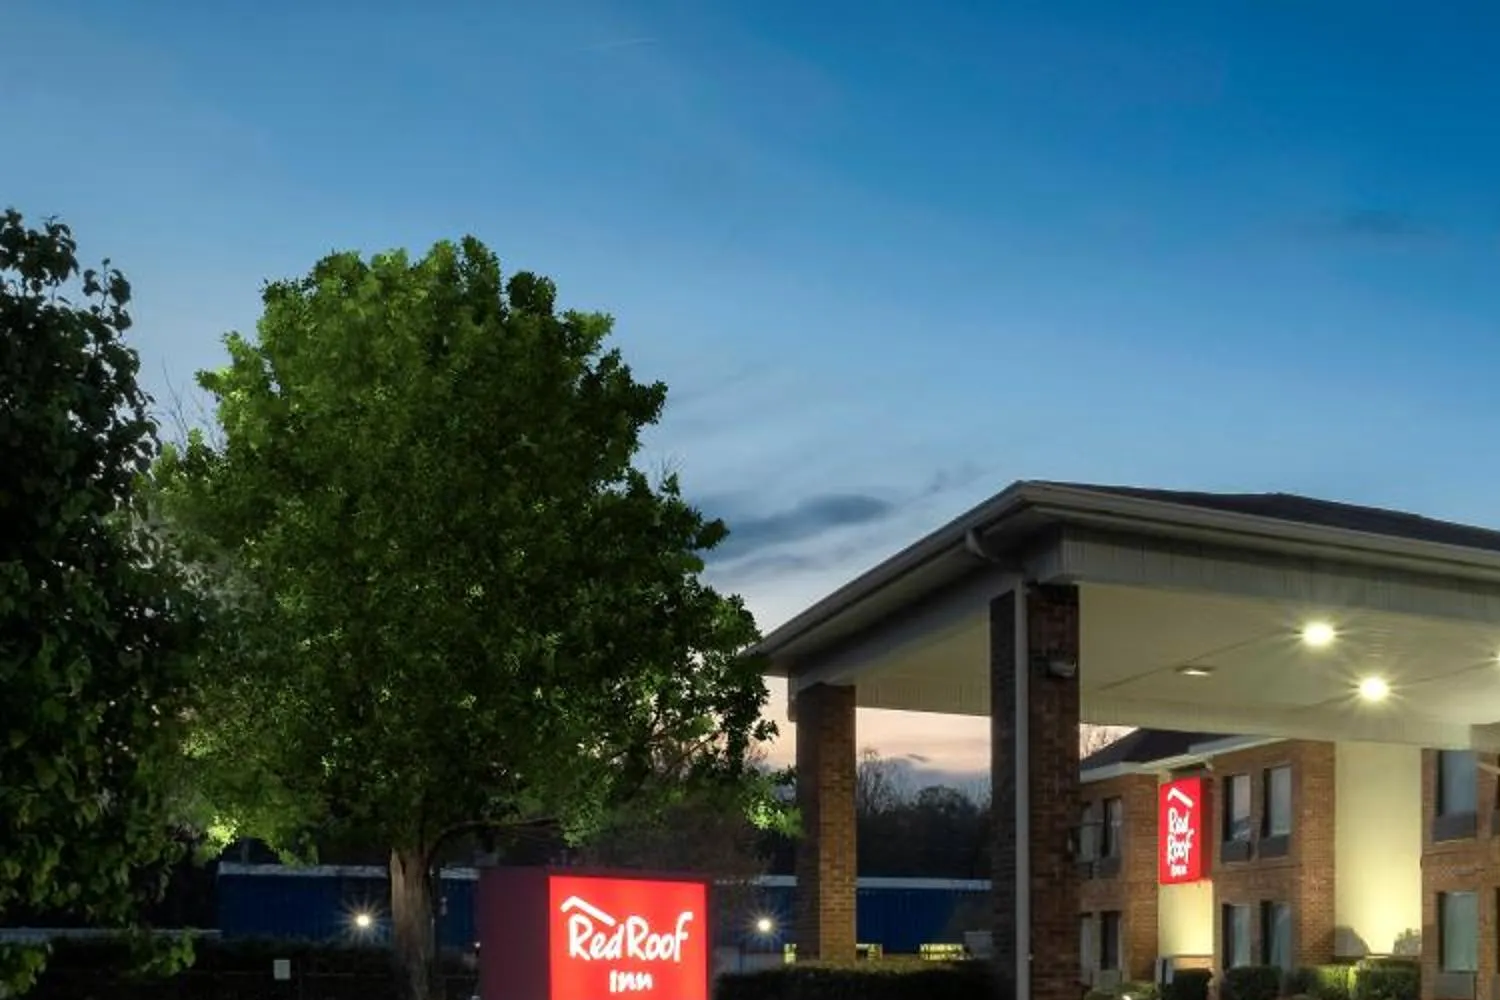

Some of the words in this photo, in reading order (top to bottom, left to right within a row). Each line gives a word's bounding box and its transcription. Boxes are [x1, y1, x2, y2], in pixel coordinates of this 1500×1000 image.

[1168, 807, 1190, 834] Red
[1167, 828, 1195, 866] Roof
[568, 913, 625, 961] Red
[625, 911, 694, 963] Roof
